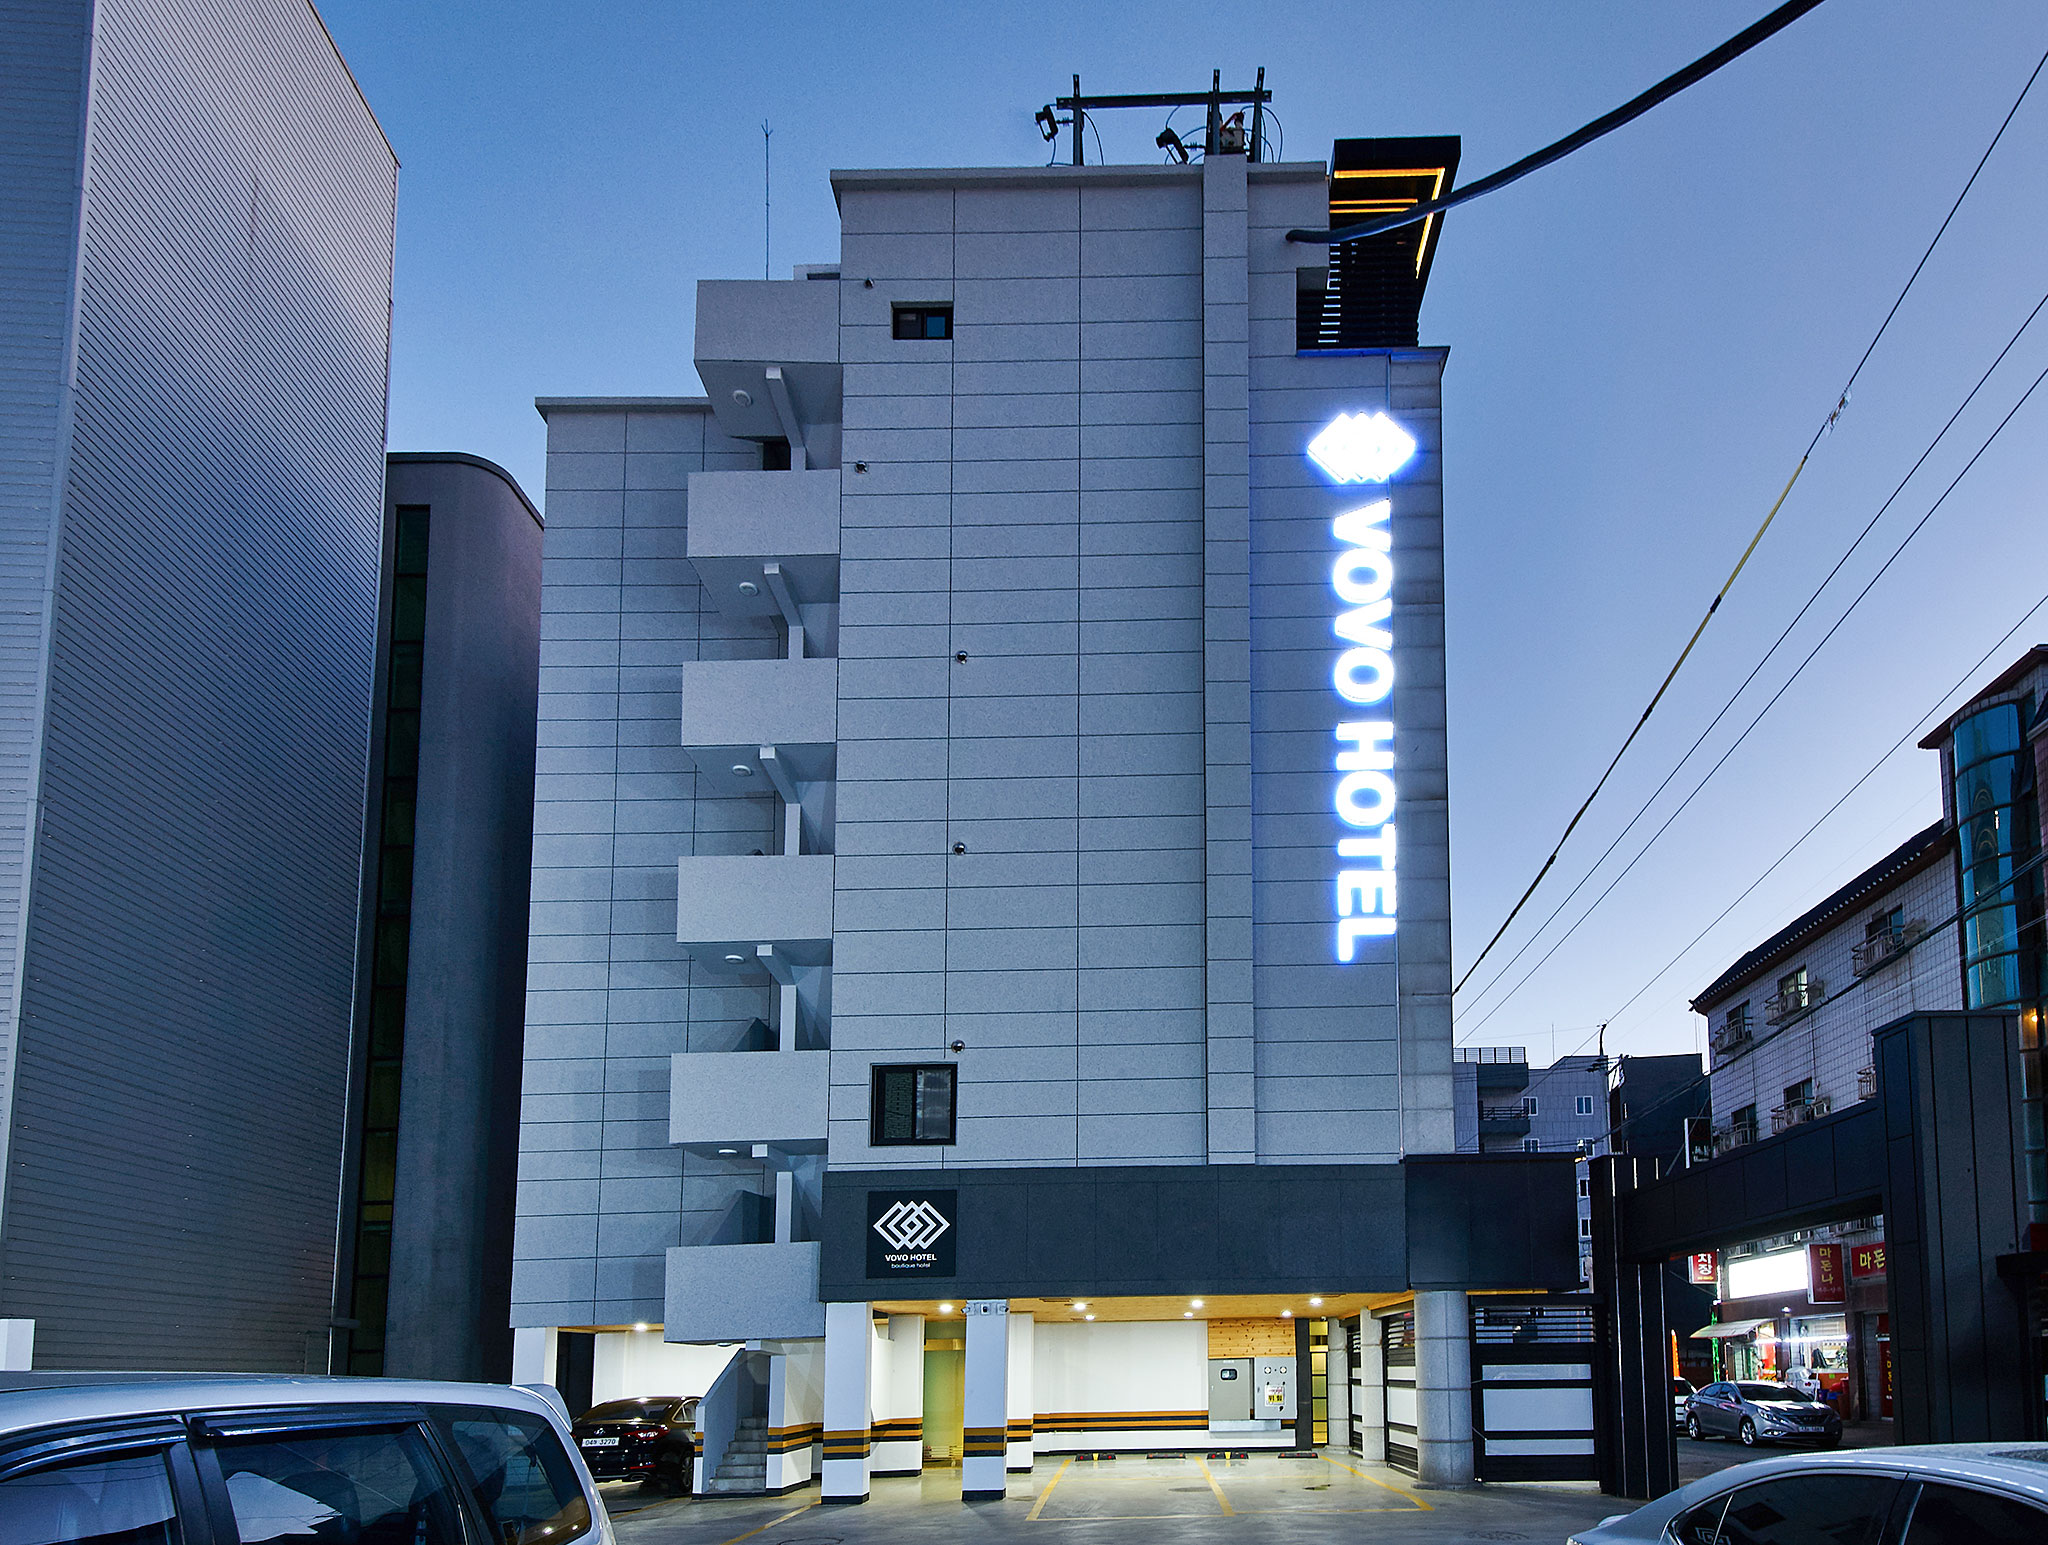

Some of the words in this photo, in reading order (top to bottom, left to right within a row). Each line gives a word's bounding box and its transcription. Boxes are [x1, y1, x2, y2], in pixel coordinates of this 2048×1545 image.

[1333, 499, 1393, 703] VOVO
[1335, 722, 1397, 961] HOTEL
[884, 1254, 908, 1262] VOVO
[910, 1253, 937, 1261] HOTEL
